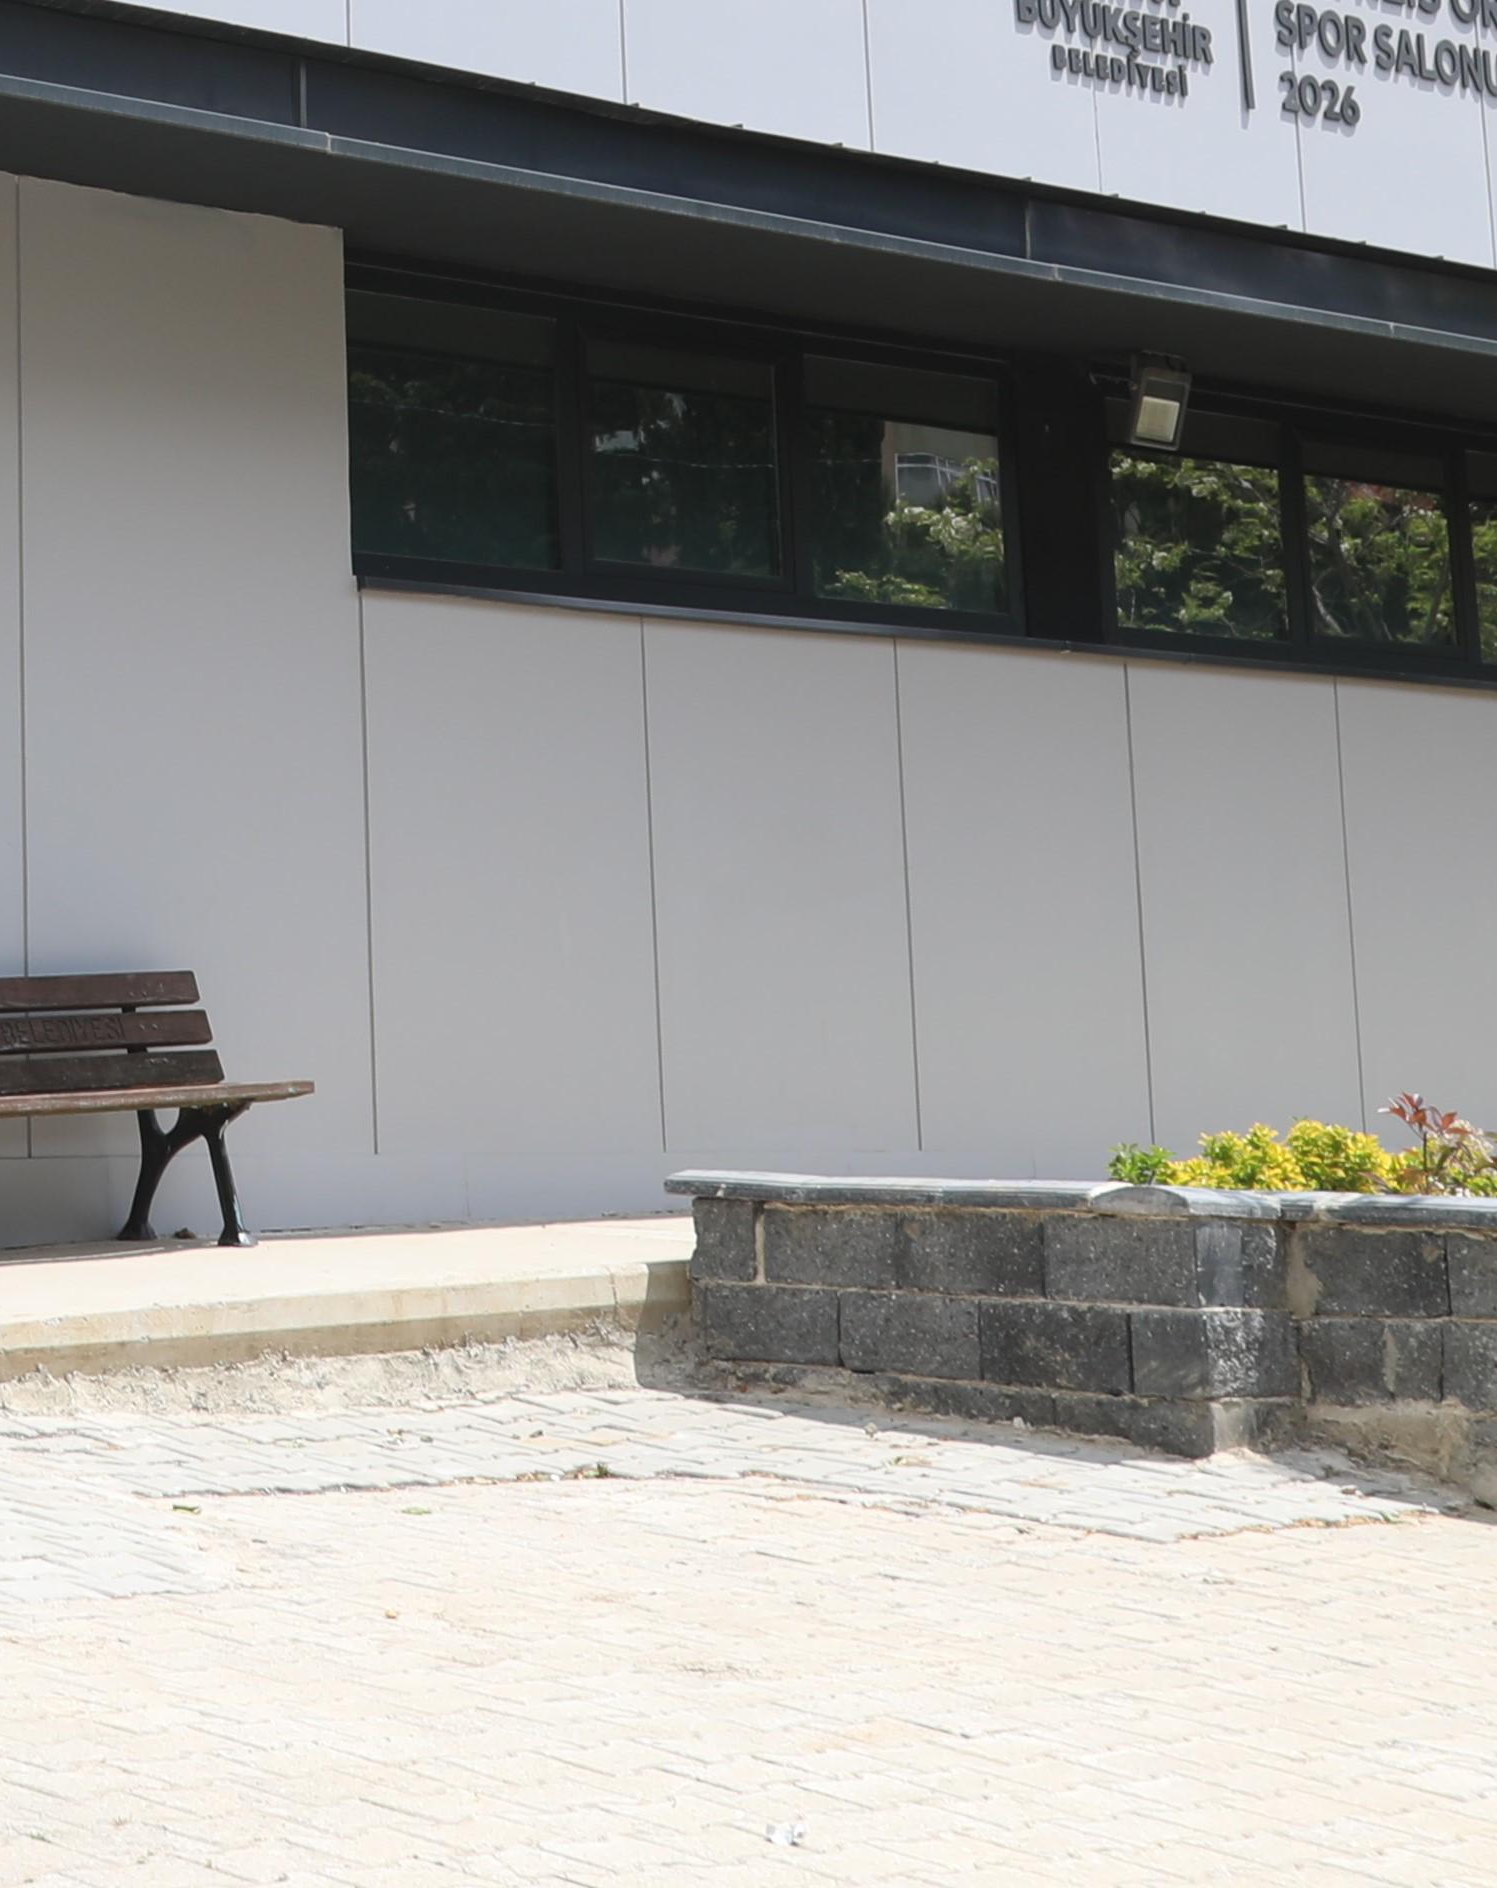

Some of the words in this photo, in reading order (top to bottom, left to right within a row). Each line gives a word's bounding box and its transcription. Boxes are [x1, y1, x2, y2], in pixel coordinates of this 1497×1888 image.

[1275, 0, 1367, 64] SPOR
[1051, 44, 1188, 97] BELEDİYESİ
[1279, 70, 1360, 126] 2026
